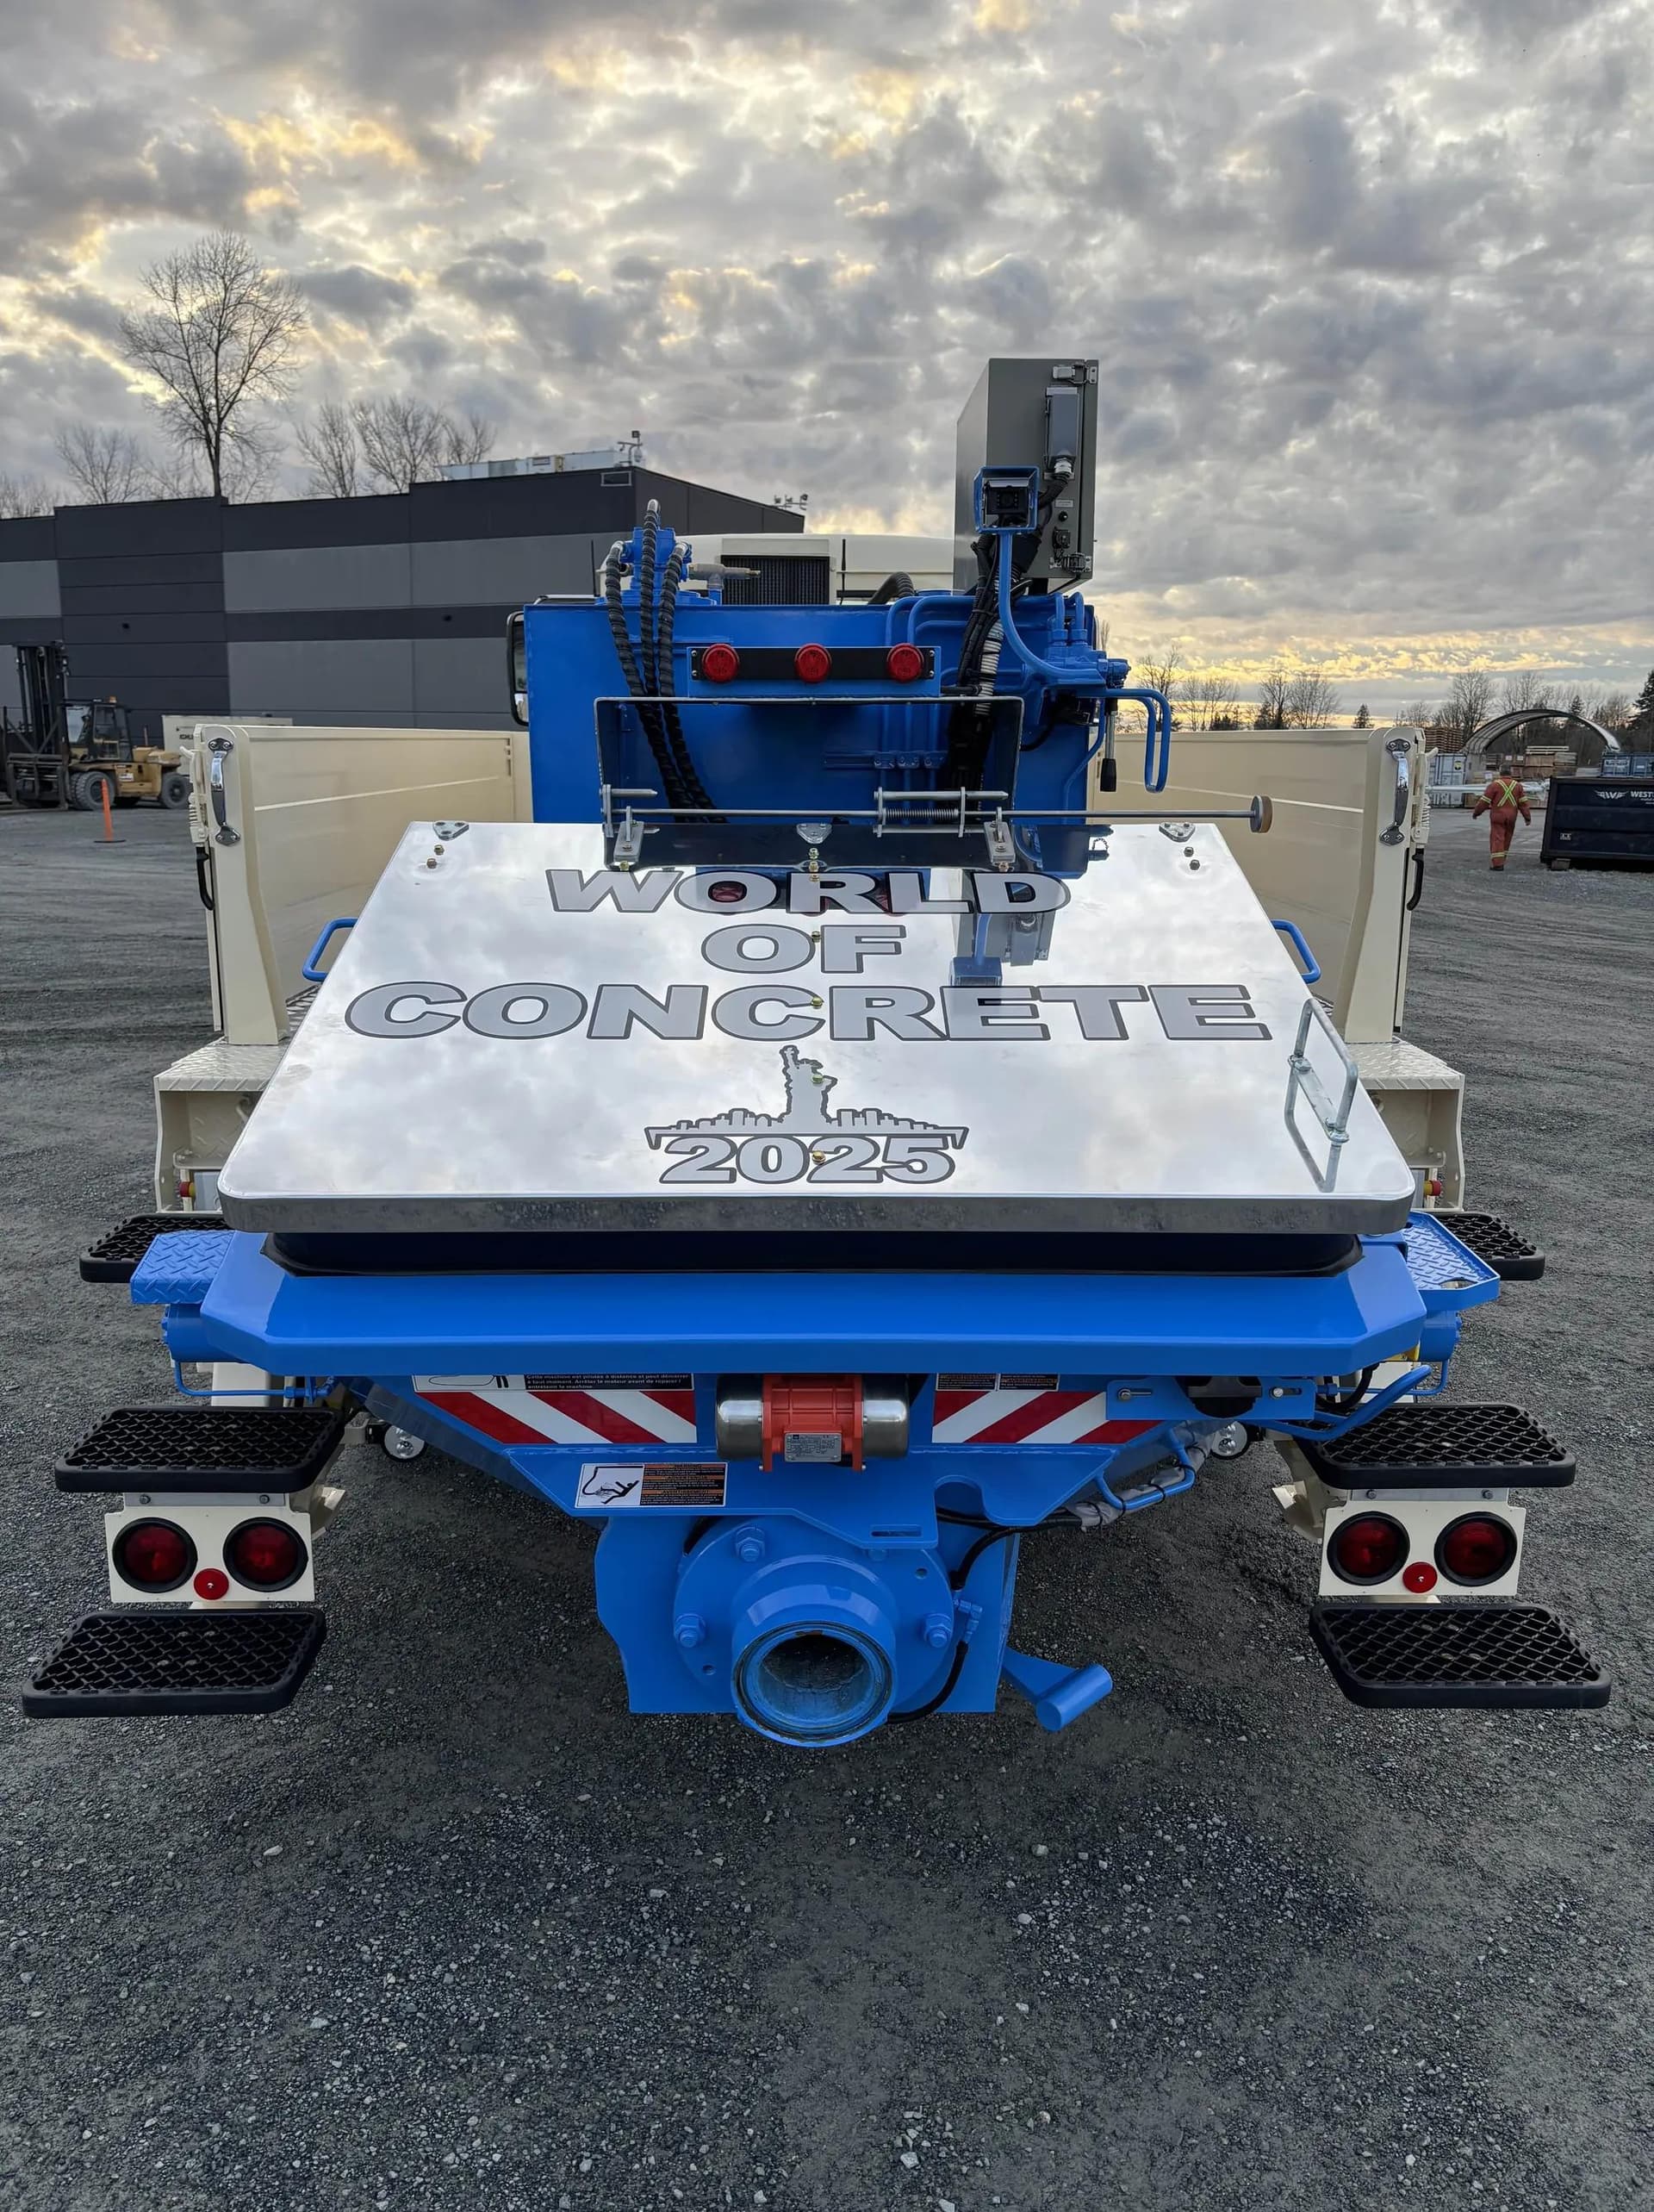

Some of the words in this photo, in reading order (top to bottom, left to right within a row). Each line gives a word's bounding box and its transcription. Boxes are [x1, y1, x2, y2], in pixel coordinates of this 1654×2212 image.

[545, 869, 1072, 913] WORLD
[700, 924, 907, 974] OF
[345, 981, 1272, 1041] CONCRETE
[659, 1135, 955, 1185] 2025
